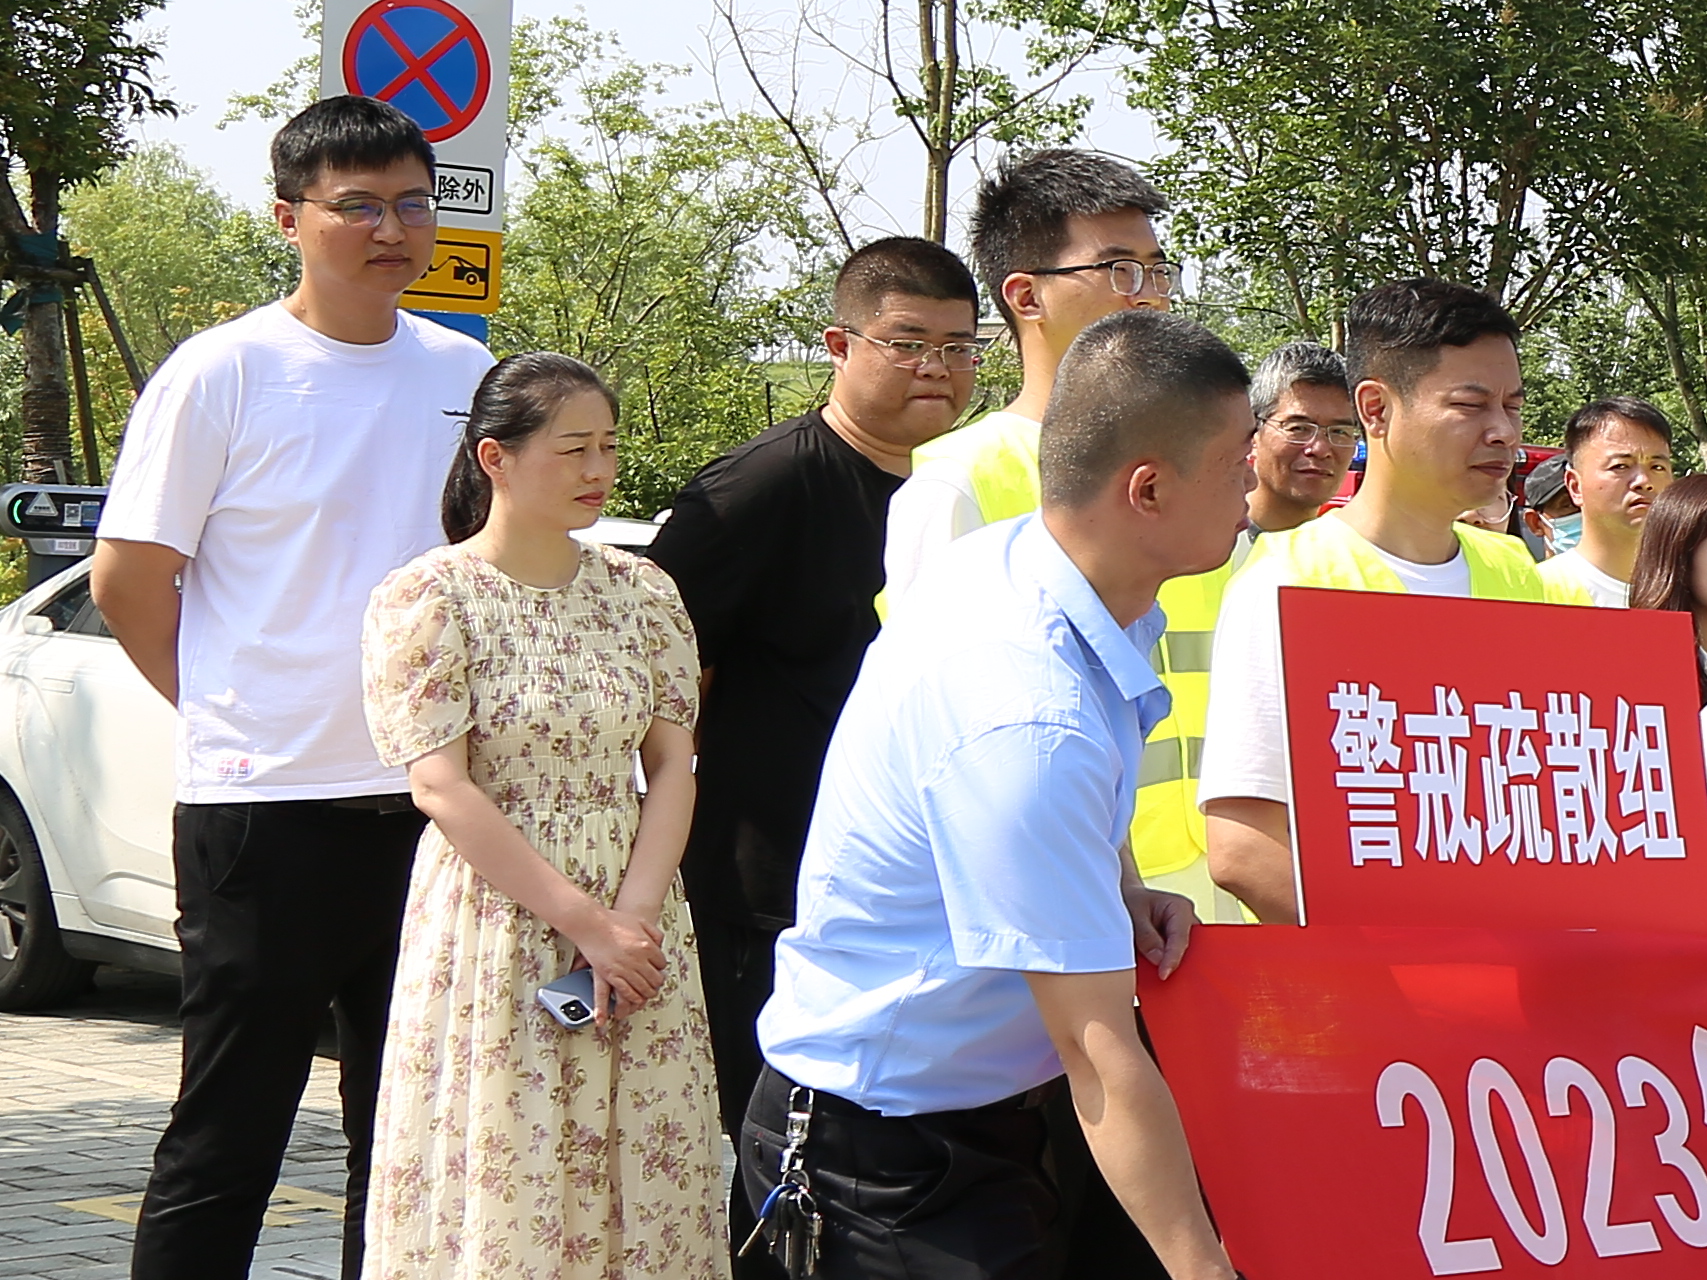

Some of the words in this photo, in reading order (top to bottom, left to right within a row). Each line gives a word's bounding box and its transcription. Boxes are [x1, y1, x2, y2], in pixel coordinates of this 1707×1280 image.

[438, 175, 485, 203] 除外
[1328, 682, 1686, 867] 警戒疏散组
